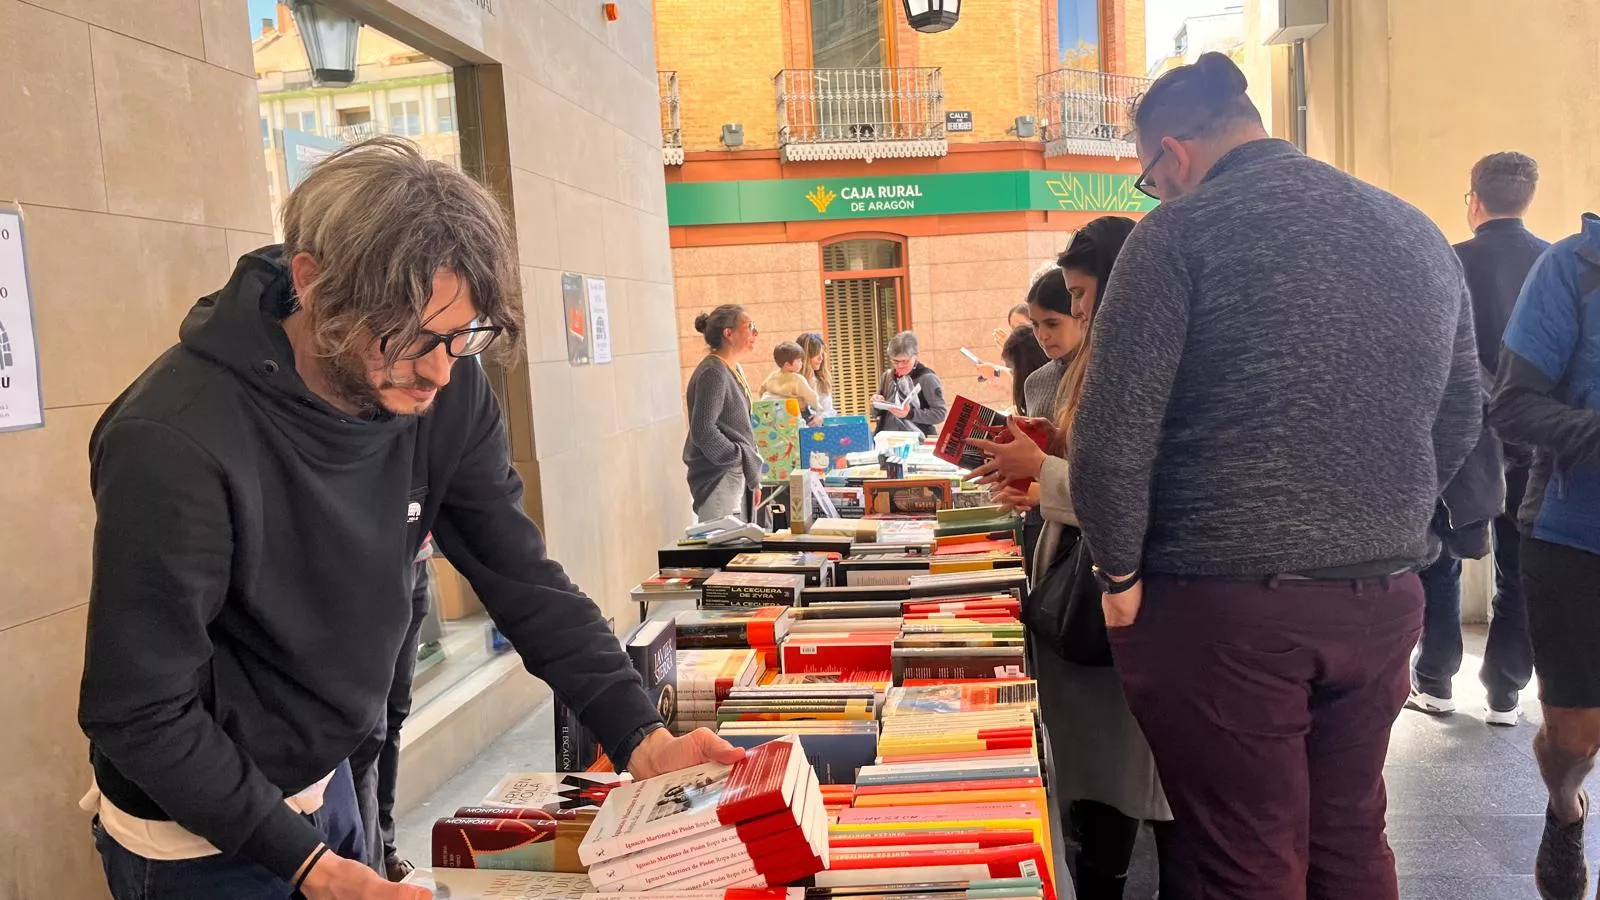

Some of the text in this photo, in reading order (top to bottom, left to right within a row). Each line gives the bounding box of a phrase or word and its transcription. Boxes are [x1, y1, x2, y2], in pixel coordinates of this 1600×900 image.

[840, 184, 923, 200] CAJA RURAL
[850, 198, 915, 212] DE ARAGÓN
[503, 778, 533, 805] ARMEN
[465, 807, 577, 815] MONFORTE LA
[444, 818, 559, 827] MONFORTE LA
[625, 839, 646, 850] Ignacio
[671, 828, 679, 836] de
[679, 824, 695, 834] Pisón
[695, 820, 710, 829] Ropa
[710, 817, 717, 825] de
[635, 859, 657, 870] Ignacio
[682, 848, 690, 856] de
[690, 843, 706, 854] Pisón
[706, 839, 721, 849] Ropa
[721, 836, 729, 844] de
[729, 833, 739, 841] cas
[645, 873, 666, 884] Ignacio
[691, 863, 699, 871] de
[699, 858, 715, 868] Pisón
[715, 855, 730, 864] Ropa
[730, 851, 738, 860] de
[737, 849, 747, 857] cas
[702, 879, 709, 887] de
[709, 874, 726, 885] Pisón
[726, 871, 741, 880] Ropa
[741, 868, 748, 876] de
